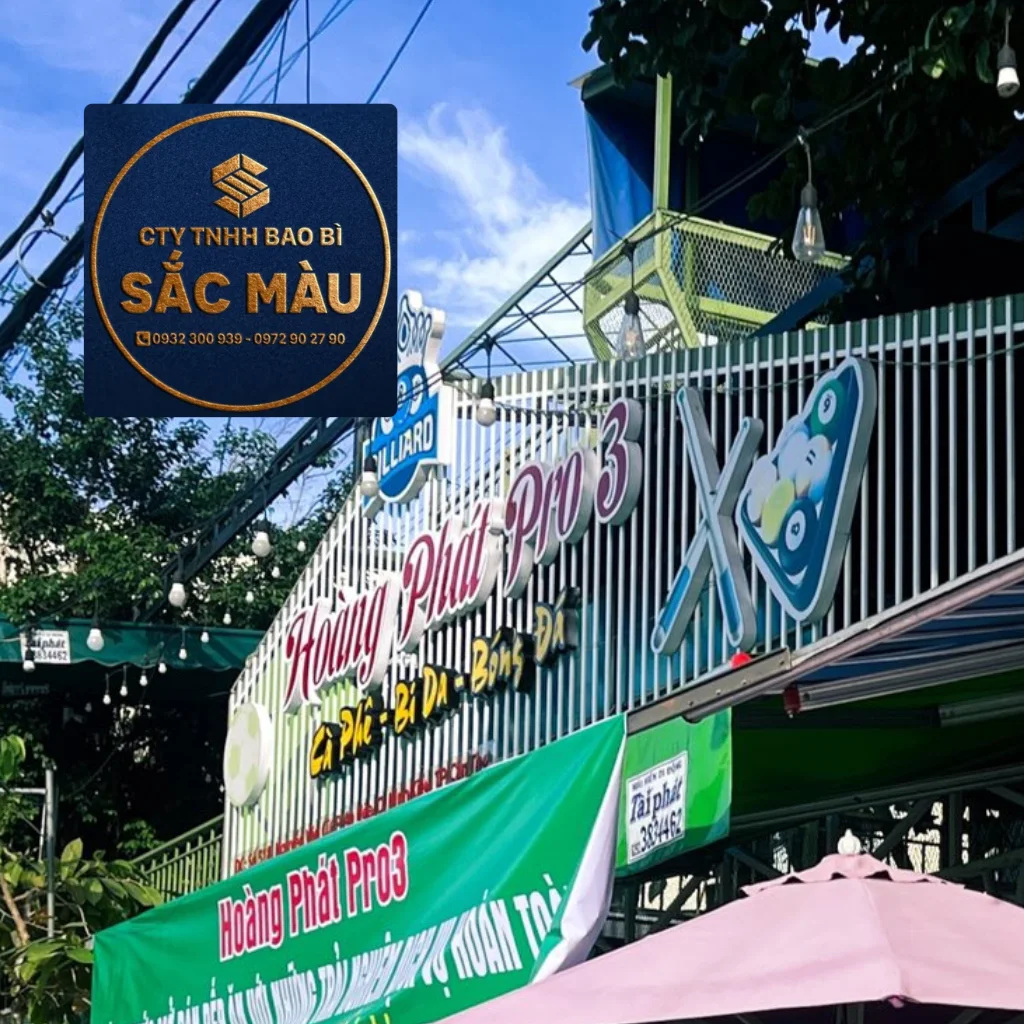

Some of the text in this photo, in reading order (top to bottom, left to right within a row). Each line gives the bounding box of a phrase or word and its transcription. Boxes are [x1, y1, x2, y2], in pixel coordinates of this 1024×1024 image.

[371, 413, 434, 480] ILLIARD
[284, 398, 631, 712] Hoàng Phát Pro 3
[309, 725, 333, 779] Cà
[339, 696, 375, 755] Phê
[394, 681, 416, 735] Bi
[470, 632, 525, 694] Bóng
[534, 587, 565, 662] Đá
[218, 830, 409, 962] Hoàng Phát Pro3
